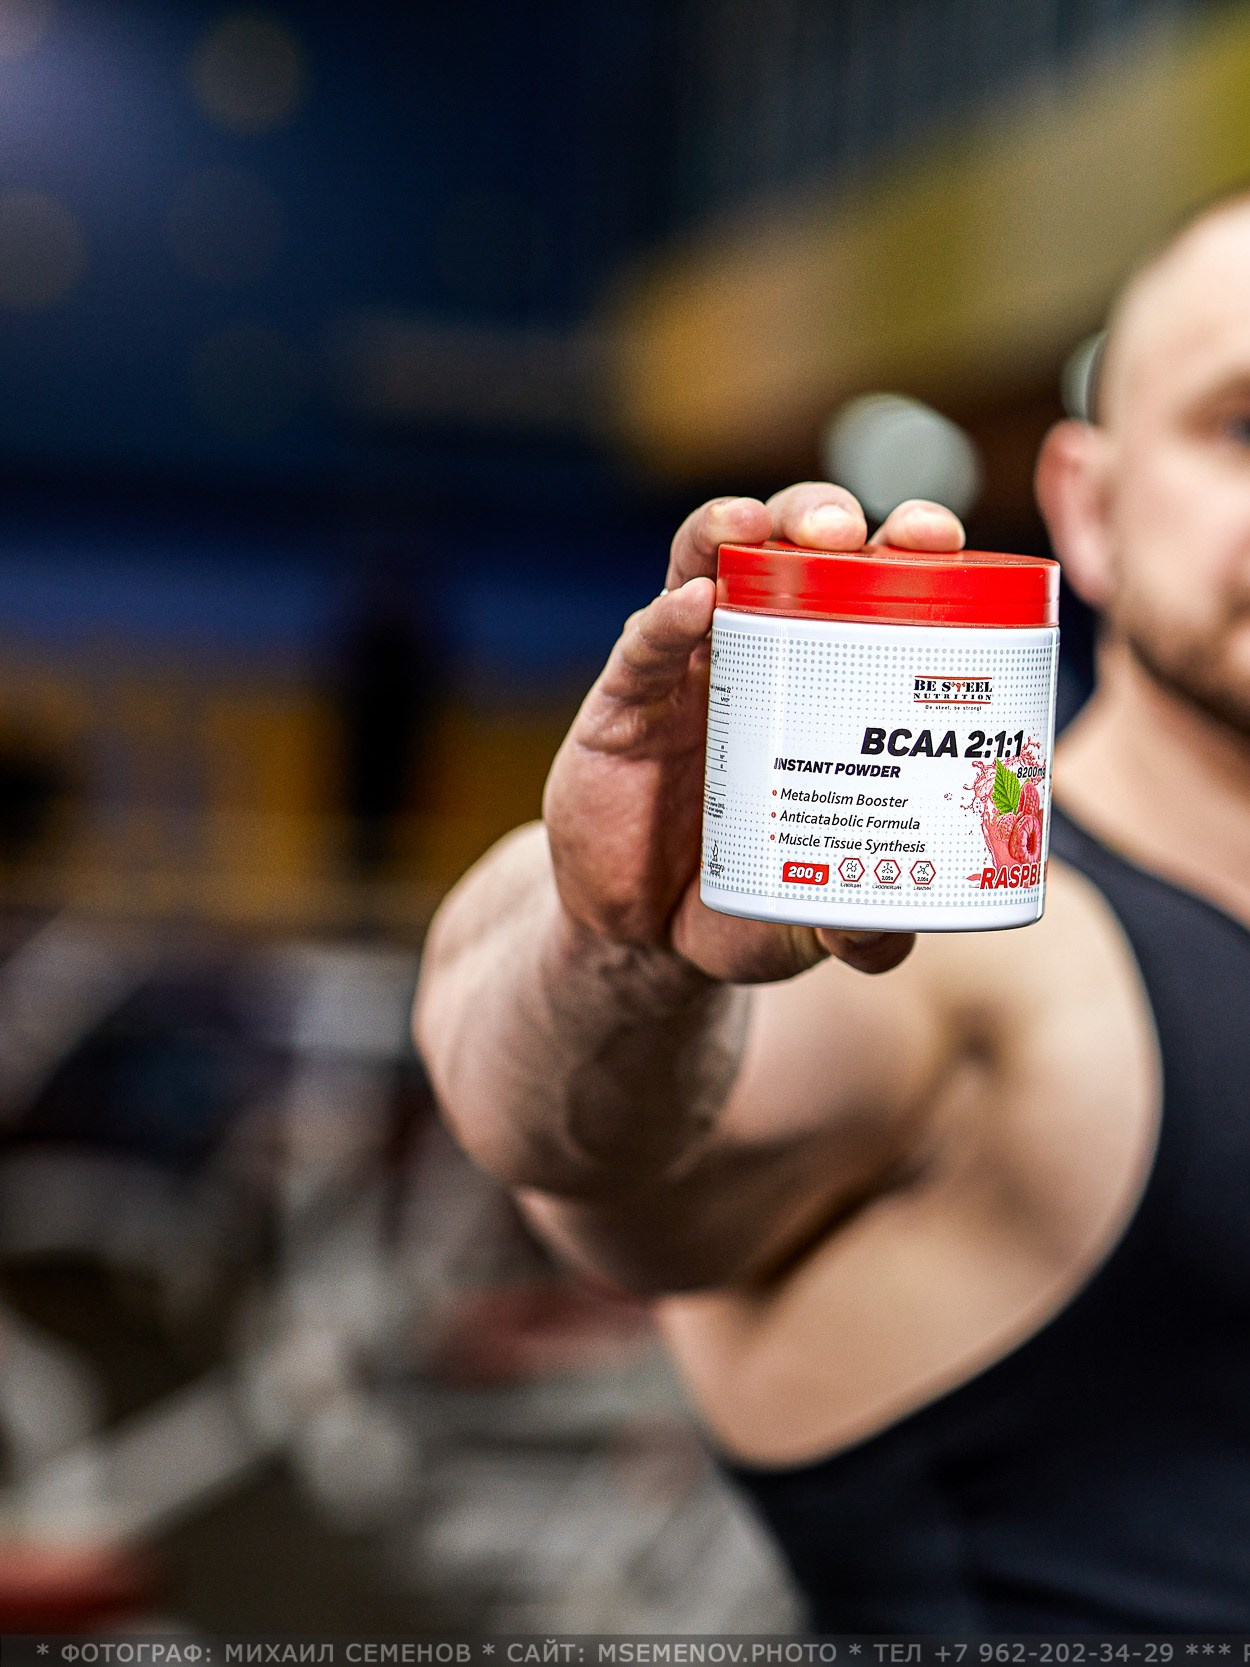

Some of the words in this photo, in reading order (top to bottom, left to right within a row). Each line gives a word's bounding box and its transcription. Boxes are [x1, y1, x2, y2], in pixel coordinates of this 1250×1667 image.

[914, 679, 937, 691] BE
[941, 681, 993, 692] STEEL
[913, 693, 992, 701] NUTRITION
[860, 727, 958, 758] BCAA
[964, 730, 1024, 758] 2:1:1
[773, 757, 834, 775] INSTANT
[834, 763, 901, 778] POWDER
[780, 788, 853, 806] Metabolism
[856, 794, 909, 808] Booster
[779, 810, 863, 828] Anticatabolic
[866, 815, 921, 830] Formula
[778, 833, 820, 847] Muscle
[823, 836, 862, 850] Tissue
[864, 839, 926, 855] Synthesis
[787, 865, 814, 879] 200
[815, 870, 824, 882] g
